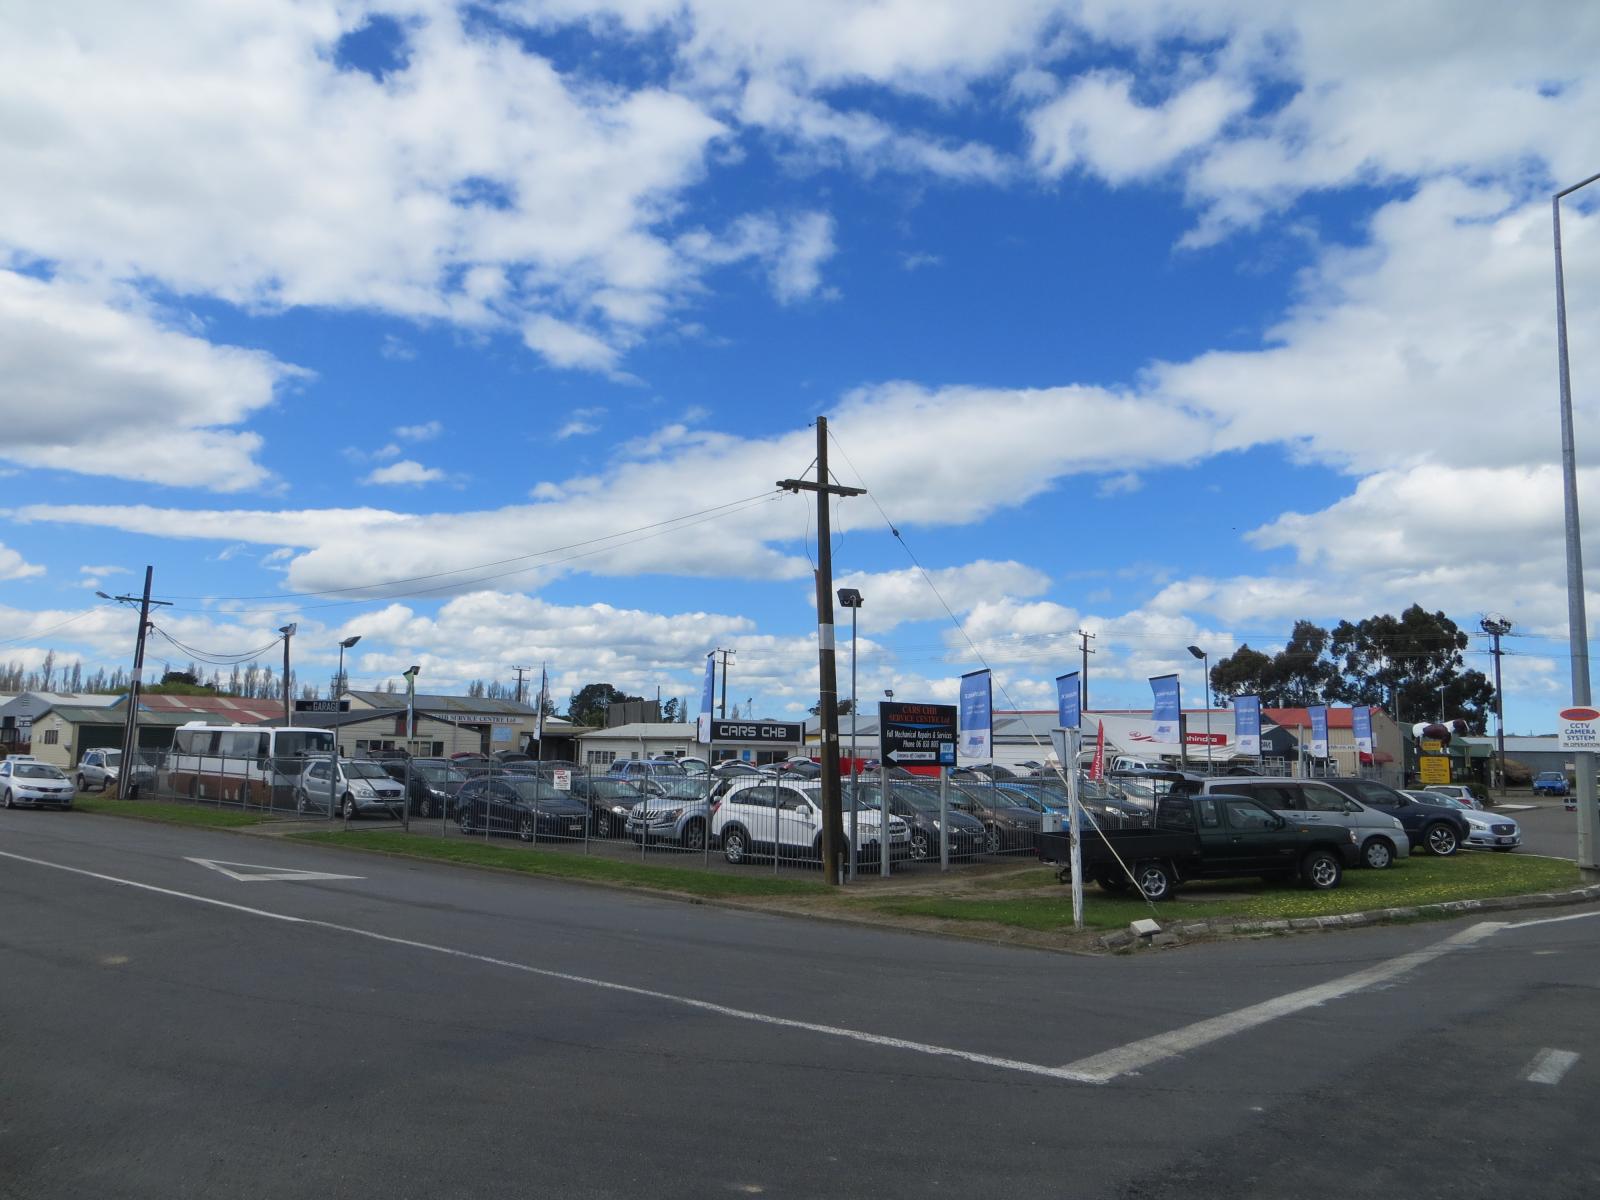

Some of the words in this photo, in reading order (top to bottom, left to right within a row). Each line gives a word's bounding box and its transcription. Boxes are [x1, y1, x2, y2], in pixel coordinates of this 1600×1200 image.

[902, 705, 920, 714] CARS
[922, 706, 937, 715] CHB
[915, 715, 940, 723] CENTRE
[719, 725, 757, 737] CARS
[761, 726, 787, 738] CHB
[894, 730, 917, 738] Mechanical
[917, 731, 932, 740] Repairs
[936, 731, 953, 739] Services
[903, 740, 915, 748] Phone
